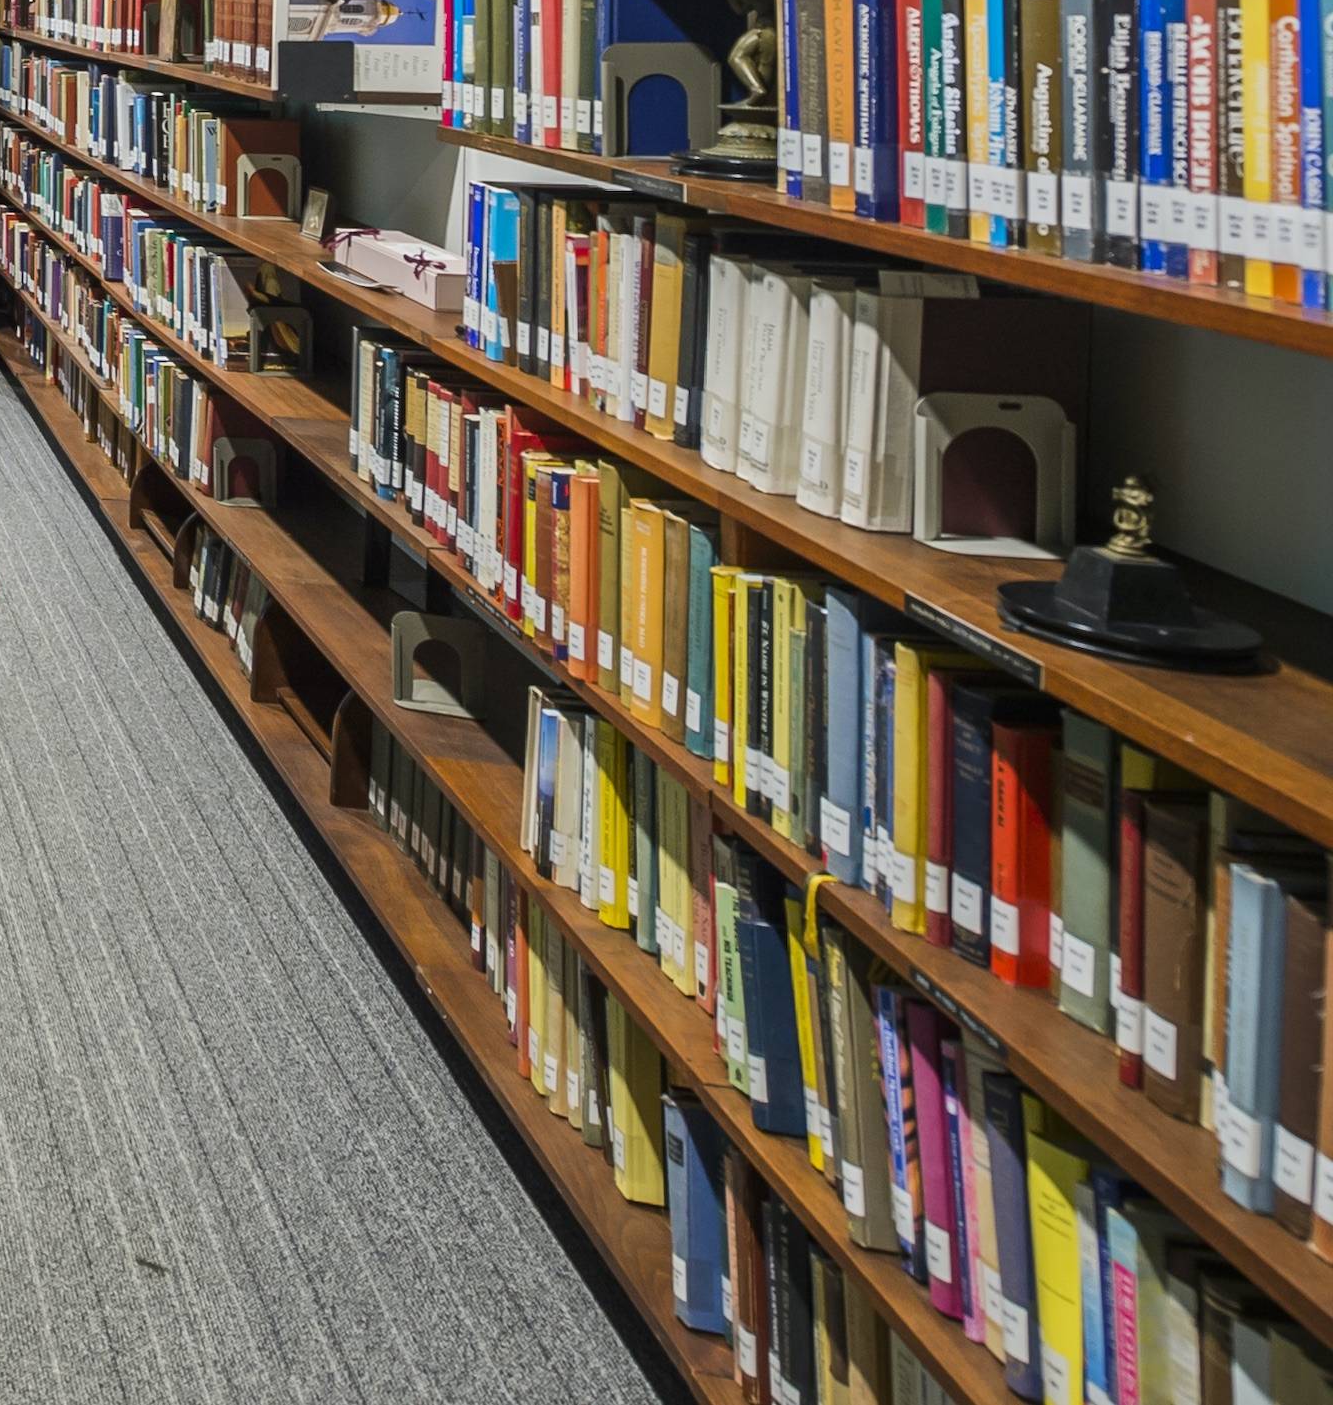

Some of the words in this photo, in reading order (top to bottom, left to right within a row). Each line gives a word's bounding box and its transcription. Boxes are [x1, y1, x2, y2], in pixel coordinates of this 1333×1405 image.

[832, 13, 845, 56] CAVE
[905, 6, 921, 65] ALBERT
[941, 13, 962, 83] Angelus
[1074, 15, 1086, 70] ROBERT
[1111, 14, 1131, 68] Elijah
[1147, 31, 1163, 87] BERNARD
[1190, 16, 1212, 106] JACOB
[832, 62, 846, 82] TO
[928, 48, 942, 95] Angela
[1276, 16, 1299, 117] Carthusian
[908, 80, 921, 144] THOMAS
[931, 96, 939, 107] of
[944, 85, 961, 155] Silesius
[1032, 63, 1053, 153] Augustine
[1074, 74, 1087, 161] BELLARMINE
[1112, 74, 1131, 182] Benamozeg
[1303, 108, 1320, 150] JOHN
[926, 109, 942, 158] Foligno
[1190, 111, 1212, 194] BOEH
[1276, 122, 1299, 204] Spirituali
[725, 957, 735, 1003] TEACHINGS
